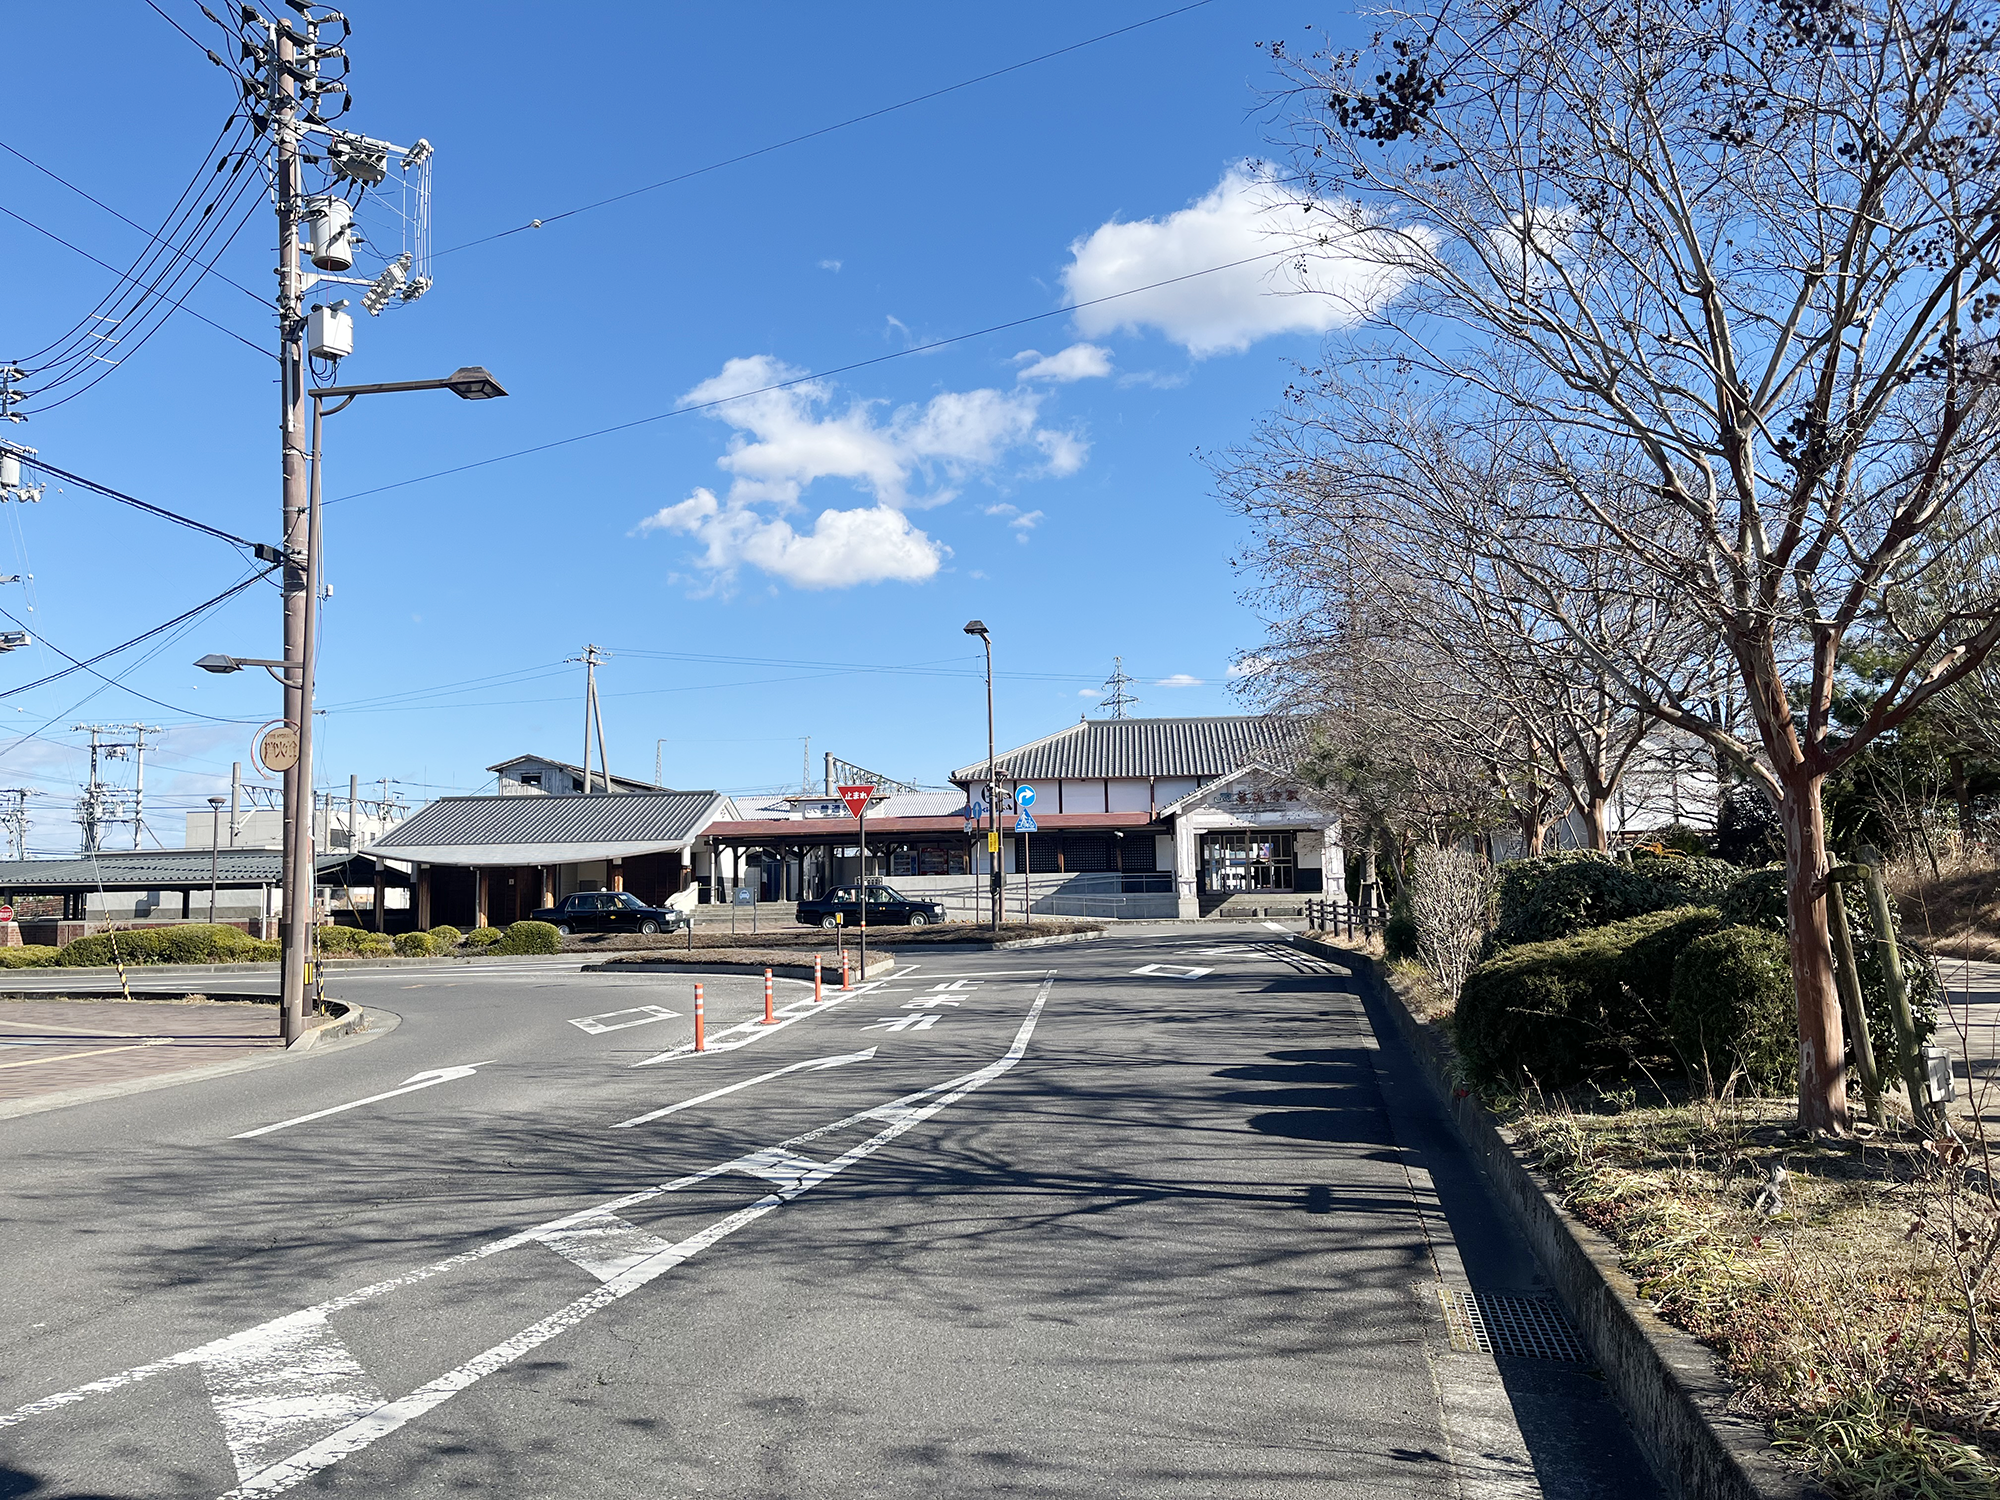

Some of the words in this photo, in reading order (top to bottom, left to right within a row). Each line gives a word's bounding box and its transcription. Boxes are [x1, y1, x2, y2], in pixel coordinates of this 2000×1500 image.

[844, 791, 868, 800] 止まれ
[860, 979, 985, 1032] 止まれ
